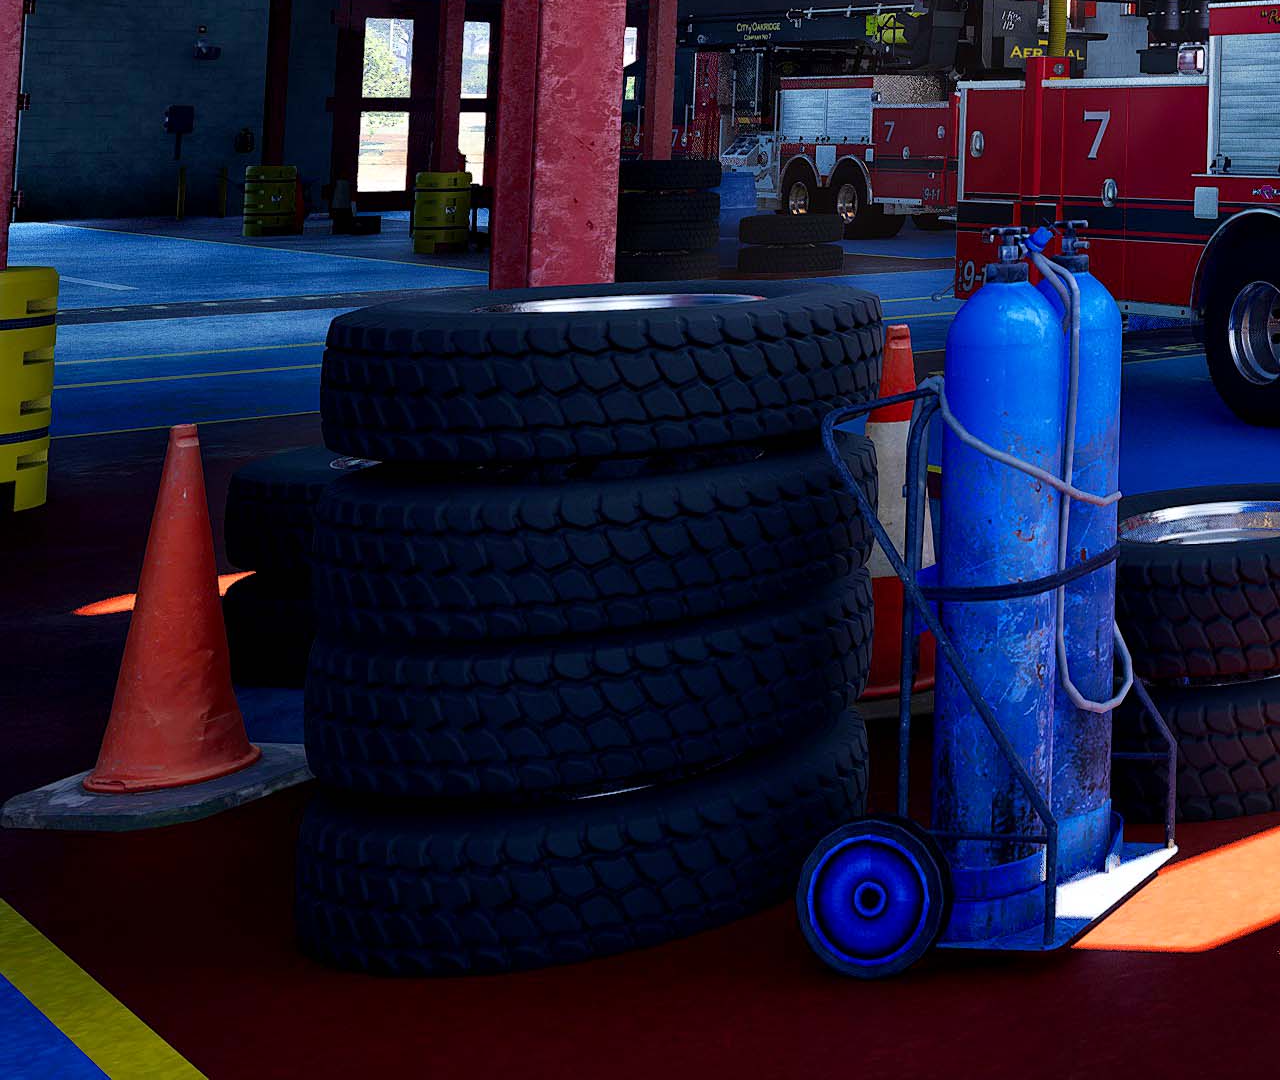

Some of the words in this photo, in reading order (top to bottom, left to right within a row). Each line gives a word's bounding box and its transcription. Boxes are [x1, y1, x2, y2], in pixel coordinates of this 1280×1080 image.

[1009, 45, 1085, 60] AERAL
[884, 120, 895, 142] 7
[1083, 108, 1111, 159] 7
